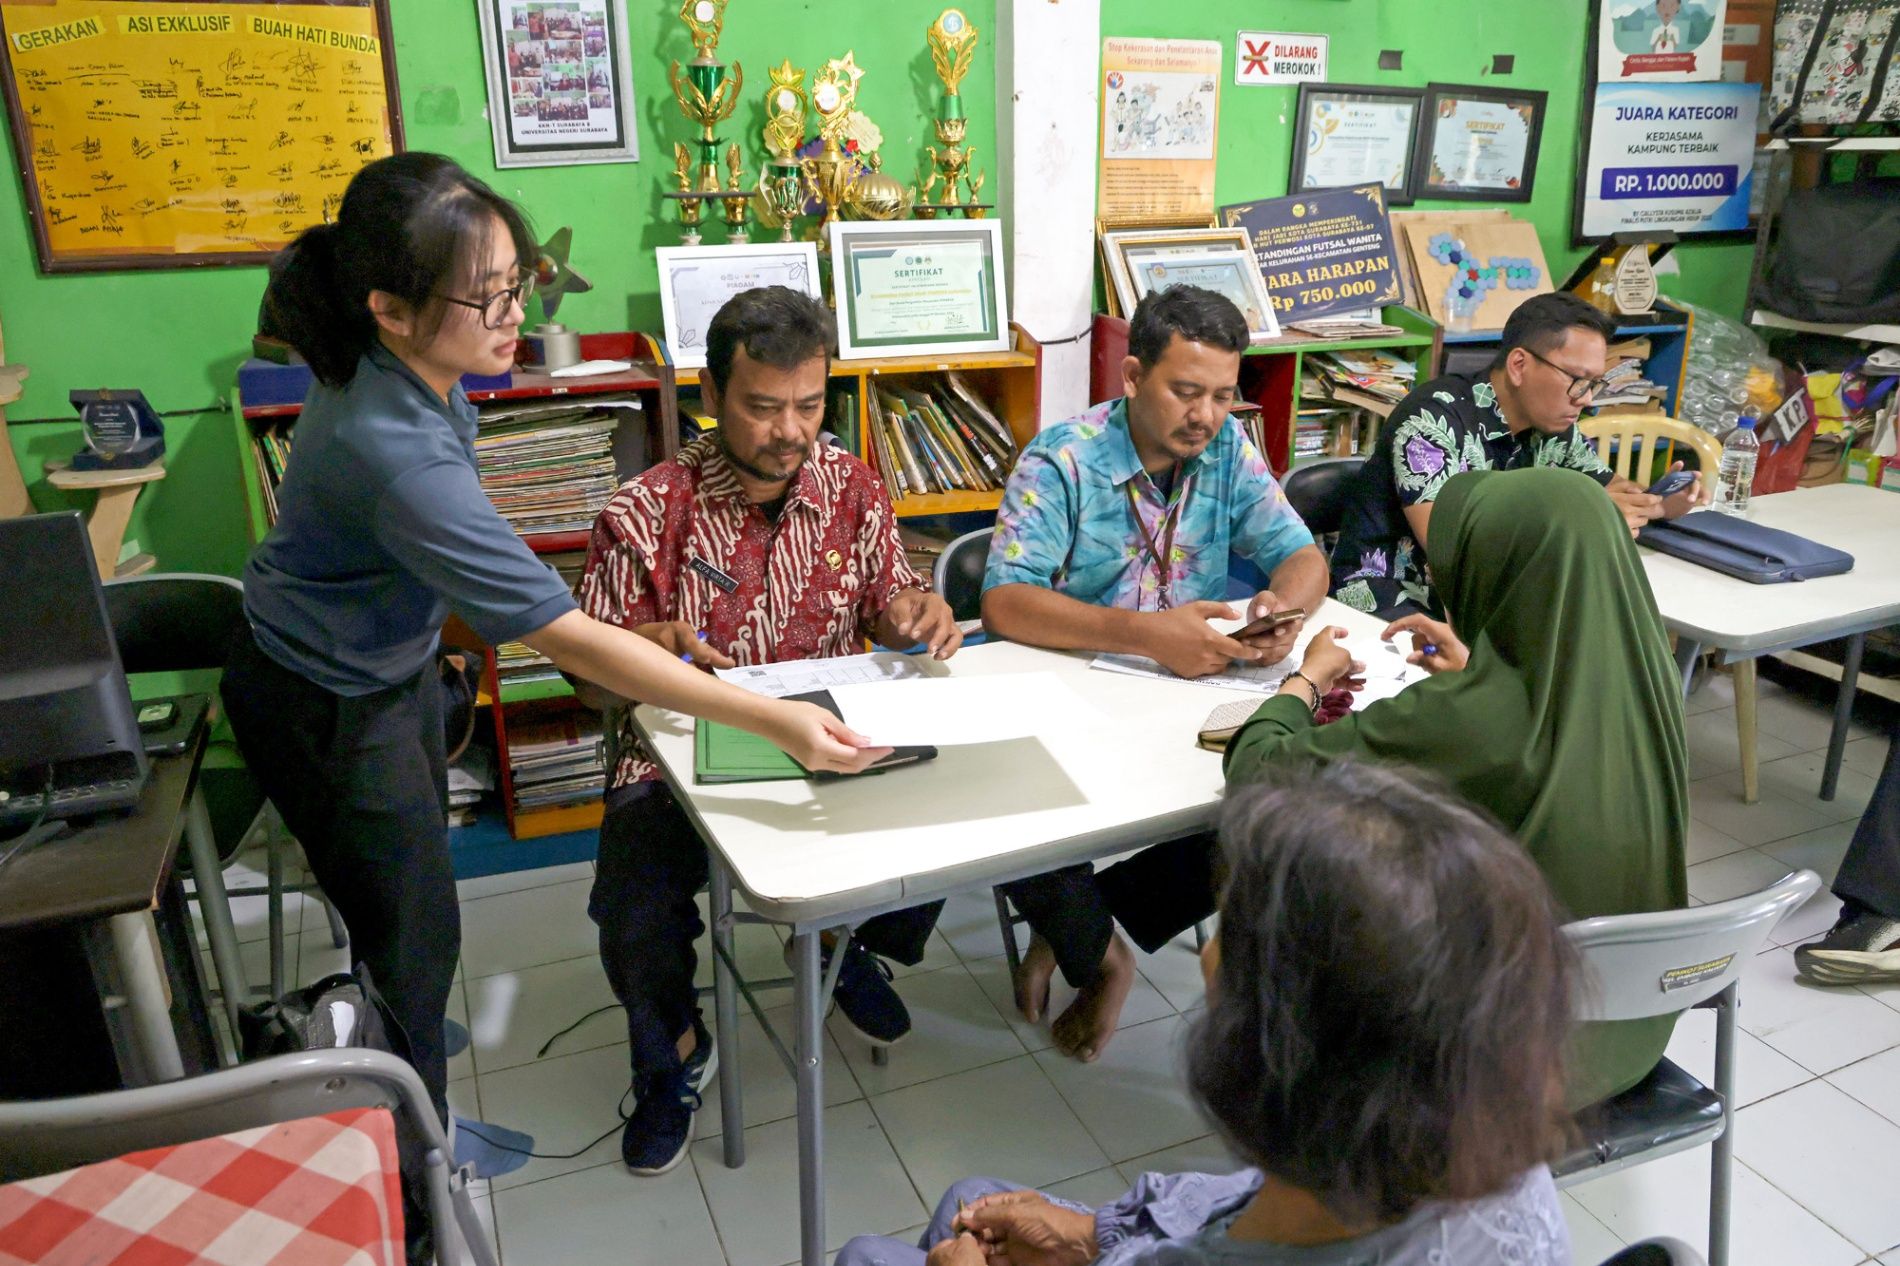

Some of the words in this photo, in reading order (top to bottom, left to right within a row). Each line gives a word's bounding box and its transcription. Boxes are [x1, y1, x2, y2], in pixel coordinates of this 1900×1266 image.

[19, 19, 99, 51] GERAKAN
[128, 17, 153, 33] ASI
[158, 15, 231, 33] EXKLUSIF
[253, 18, 292, 38] BUAH
[297, 24, 327, 45] HATI
[330, 28, 377, 54] BUNDA
[1274, 45, 1318, 59] DILARANG
[1273, 62, 1316, 75] MEROKOK
[1615, 106, 1664, 121] JUARA
[1668, 106, 1738, 121] KATEGORI
[520, 128, 557, 136] UNIVERSITAS
[559, 127, 579, 135] NEGERI
[1645, 131, 1704, 142] KERJASAMA
[1627, 143, 1677, 154] KAMPUNG
[1680, 143, 1720, 154] TERBAIK
[1615, 174, 1642, 192] RP.
[1646, 172, 1725, 192] 1.000.000
[1254, 234, 1271, 242] HARI
[1288, 228, 1305, 238] KOTA
[1258, 226, 1281, 236] DALAM
[1313, 239, 1347, 252] FUTSAL
[1347, 233, 1383, 246] WANITA
[1268, 256, 1305, 267] KELURAHAN
[1353, 243, 1381, 253] GENTENG
[894, 267, 944, 278] SERTIFIKAT
[1264, 271, 1304, 290] ARA
[1306, 255, 1390, 283] HARAPAN
[1270, 295, 1294, 313] Rp
[1300, 279, 1377, 305] 750.000
